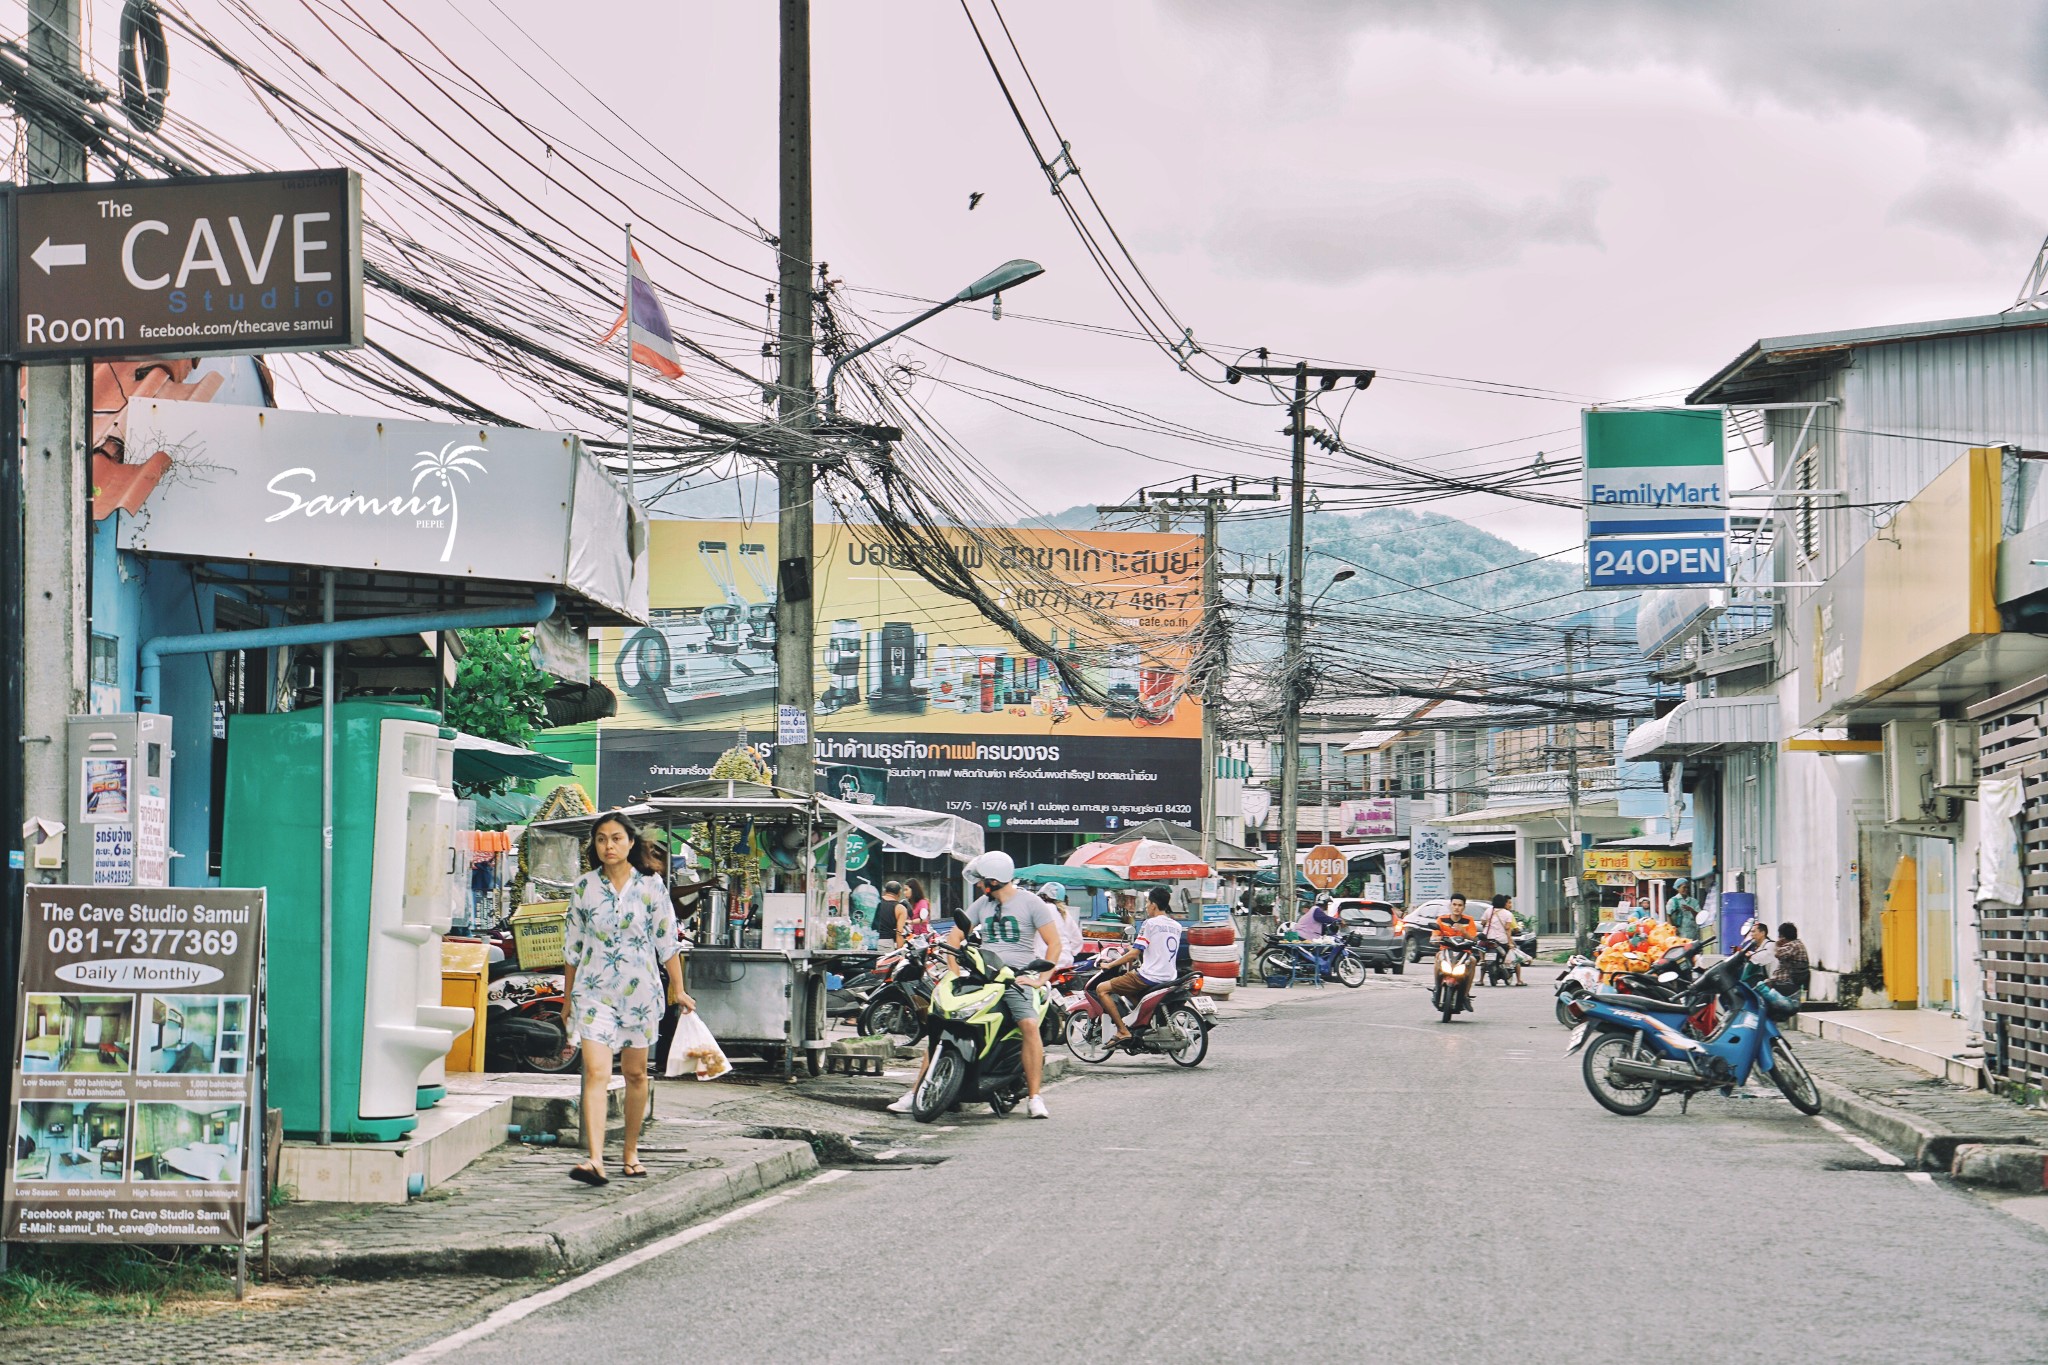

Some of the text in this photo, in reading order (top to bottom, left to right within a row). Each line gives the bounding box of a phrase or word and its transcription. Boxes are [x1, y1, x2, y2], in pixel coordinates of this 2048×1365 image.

[98, 200, 133, 218] The
[122, 212, 331, 290] CAVE
[169, 287, 333, 313] Studio
[26, 314, 125, 344] Room
[140, 317, 333, 338] facebook.com/thecave samui
[1592, 482, 1720, 508] FamilyMart
[1595, 548, 1720, 576] 24OPEN
[1082, 590, 1119, 610] 427
[1128, 591, 1190, 612] 486-7
[946, 801, 972, 811] 157/5
[982, 801, 1008, 811] 157/6
[1165, 804, 1192, 814] 84320
[96, 825, 132, 842] รถรับจ้าง
[114, 843, 121, 856] 6
[1150, 852, 1177, 860] Chang
[1306, 859, 1345, 882] หยุด
[41, 902, 250, 924] The Cave Studio Samui
[983, 915, 1020, 943] 10
[47, 927, 238, 955] 081-7377369
[1166, 936, 1177, 962] 9
[76, 965, 117, 982] Daily
[133, 965, 200, 983] Monthly
[23, 1079, 38, 1087] Low
[135, 1079, 152, 1088] High
[15, 1188, 31, 1196] Low
[31, 1189, 60, 1197] Season:
[67, 1189, 80, 1197] 600
[132, 1189, 148, 1198] High
[20, 1208, 230, 1222] Facebook page: The Cave Studio Samui
[19, 1223, 220, 1236] E-Mail: samui_the_cave@hotmail.com
